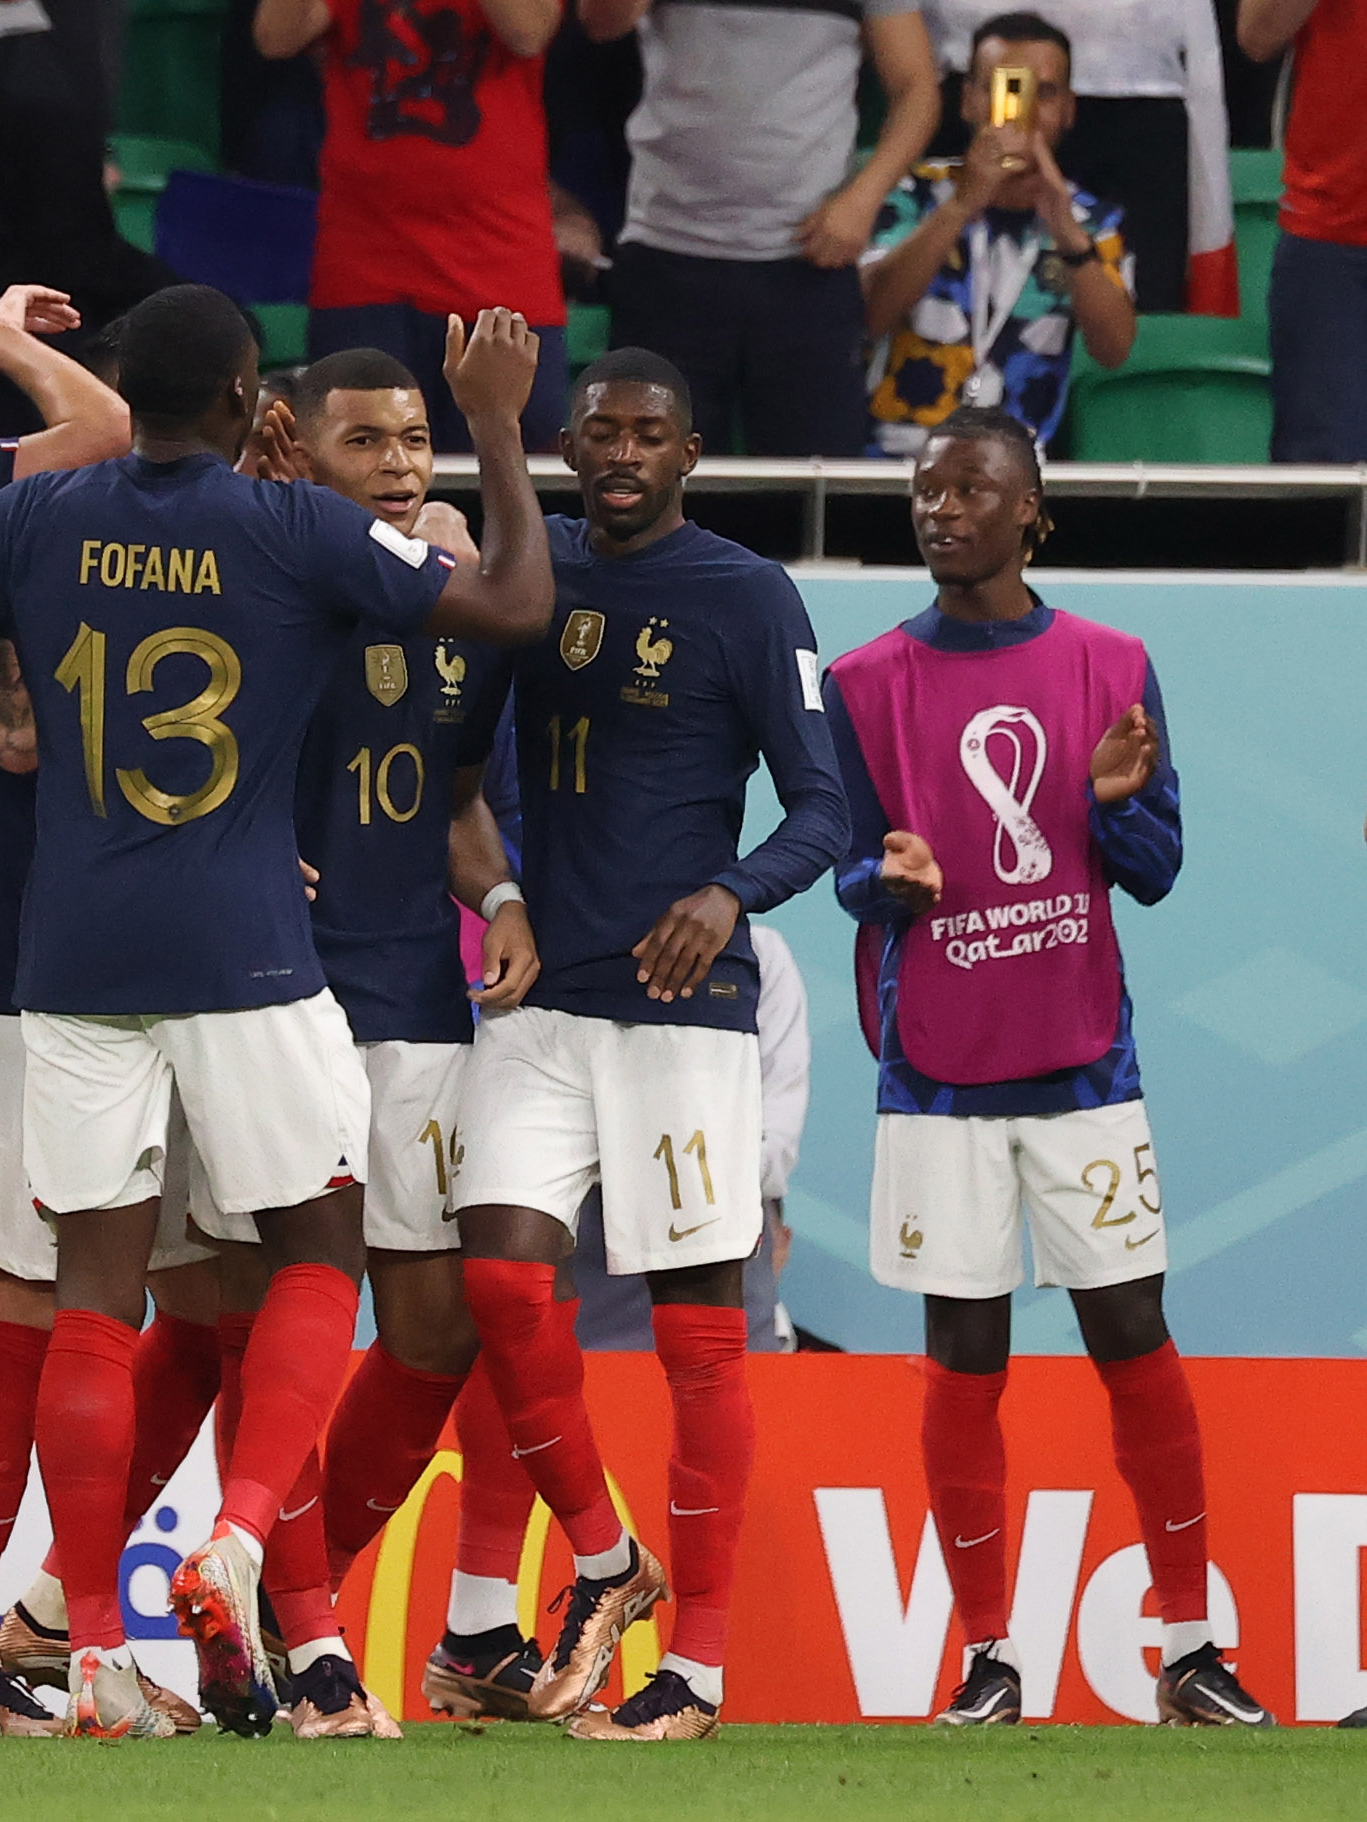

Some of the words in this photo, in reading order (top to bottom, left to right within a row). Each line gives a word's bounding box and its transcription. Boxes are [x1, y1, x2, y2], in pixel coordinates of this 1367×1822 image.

[79, 540, 222, 595] FOFANA
[54, 621, 242, 826] 13
[546, 715, 591, 794] 11
[346, 742, 425, 826] 10
[931, 910, 986, 941] FIFA
[985, 894, 1073, 931] WORLD
[652, 1129, 716, 1210] 11
[1081, 1142, 1161, 1230] 25
[813, 1486, 1241, 1724] We
